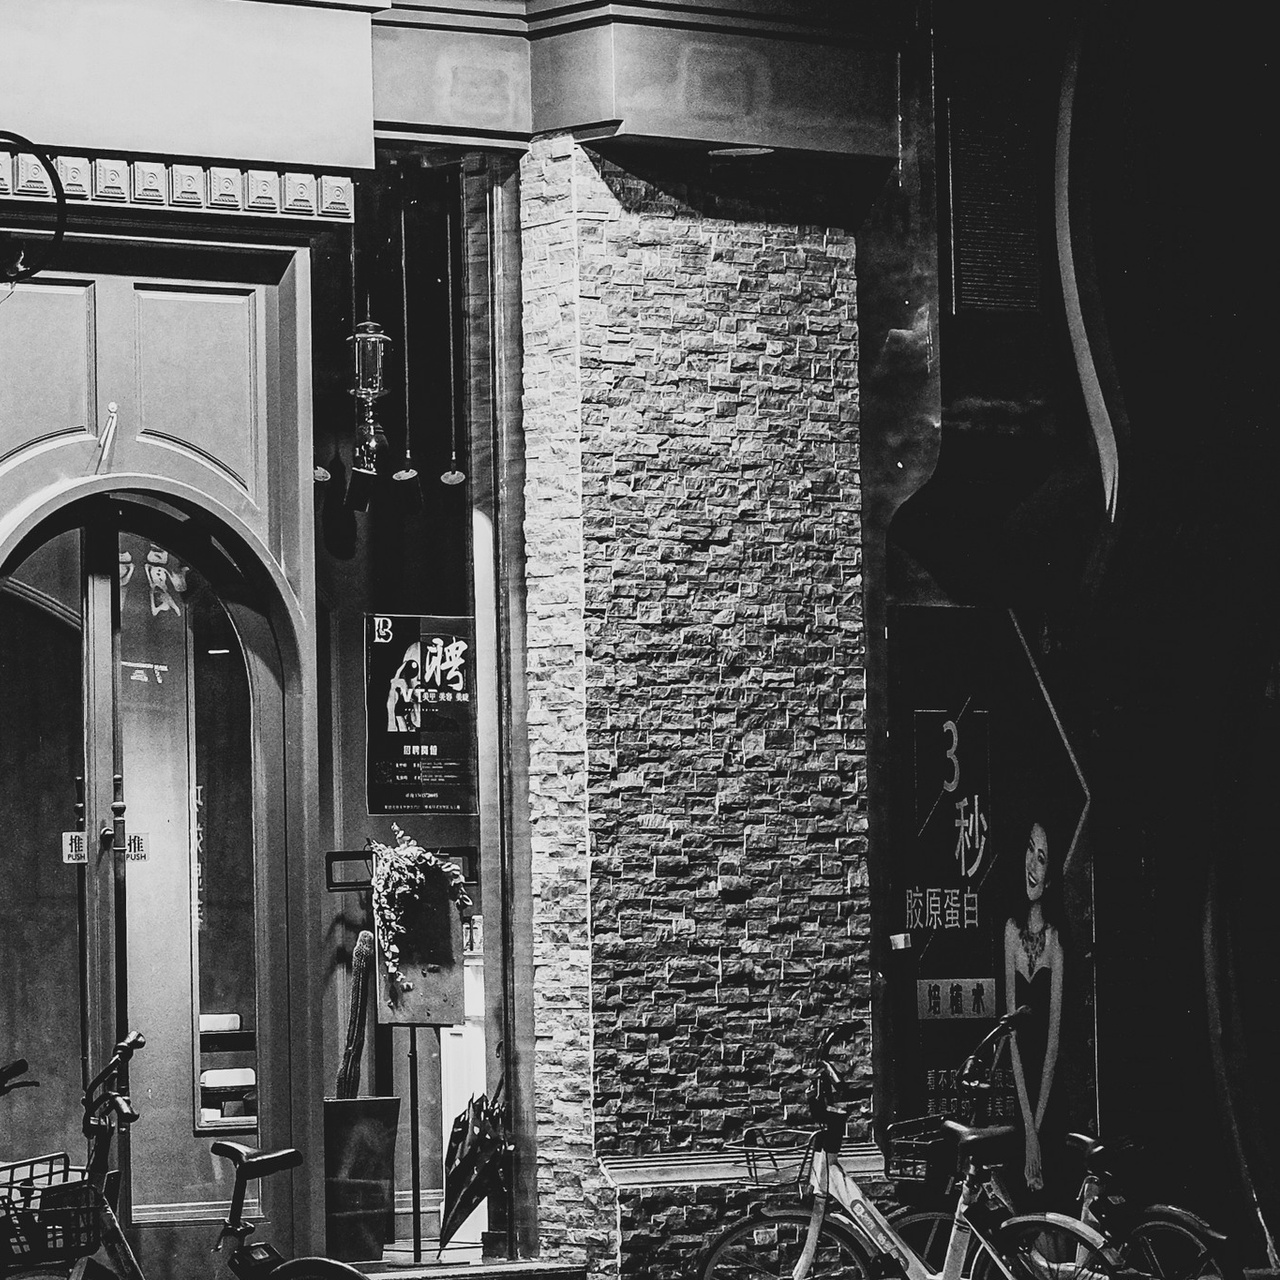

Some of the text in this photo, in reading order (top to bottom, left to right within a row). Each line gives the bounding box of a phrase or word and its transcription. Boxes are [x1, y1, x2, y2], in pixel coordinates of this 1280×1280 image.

[943, 721, 960, 792] 3
[67, 853, 86, 861] PUSH
[125, 853, 147, 861] PUSH
[955, 794, 988, 878] 秒
[905, 885, 979, 930] 胶原蛋白
